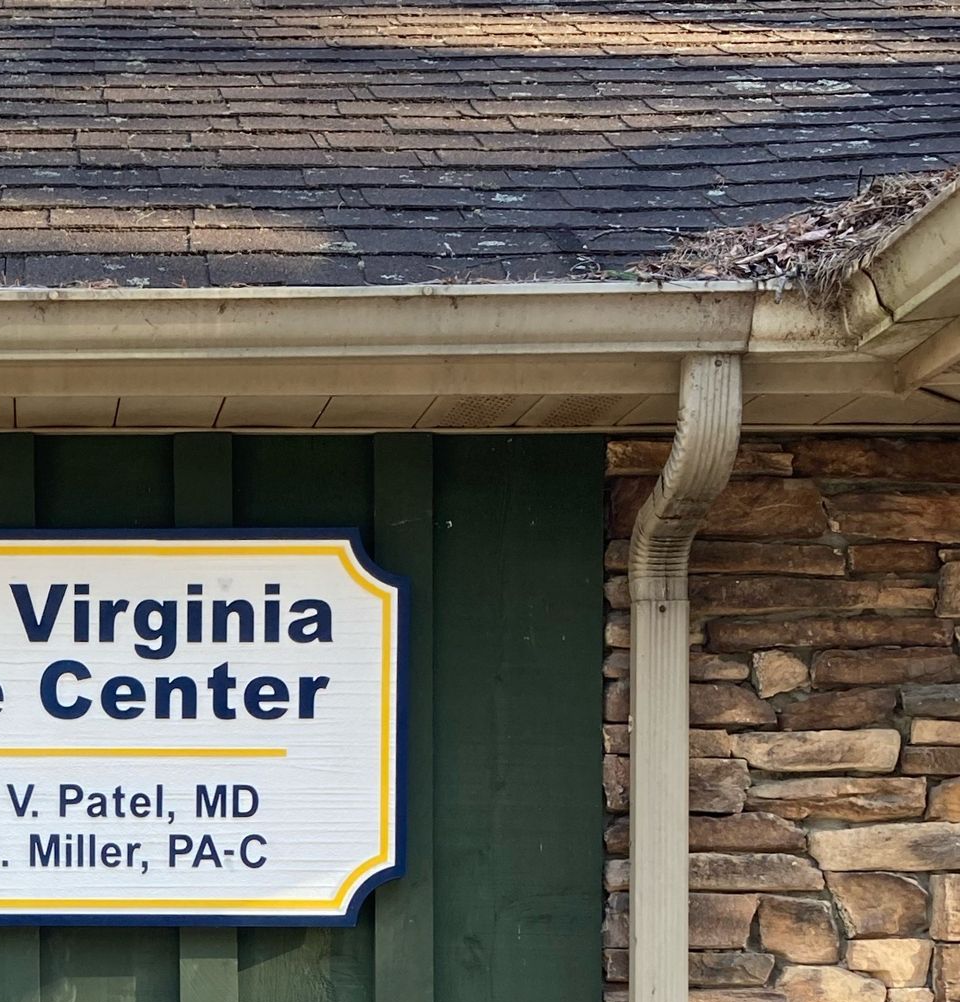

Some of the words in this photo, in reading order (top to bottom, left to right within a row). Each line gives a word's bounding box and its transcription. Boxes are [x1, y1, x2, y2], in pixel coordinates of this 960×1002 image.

[8, 583, 334, 661] Virginia
[39, 659, 331, 721] Center
[6, 783, 39, 818] V.
[59, 783, 175, 825] Patel,
[196, 784, 259, 818] MD
[29, 833, 148, 875] Miller,
[168, 833, 267, 869] PA-C
